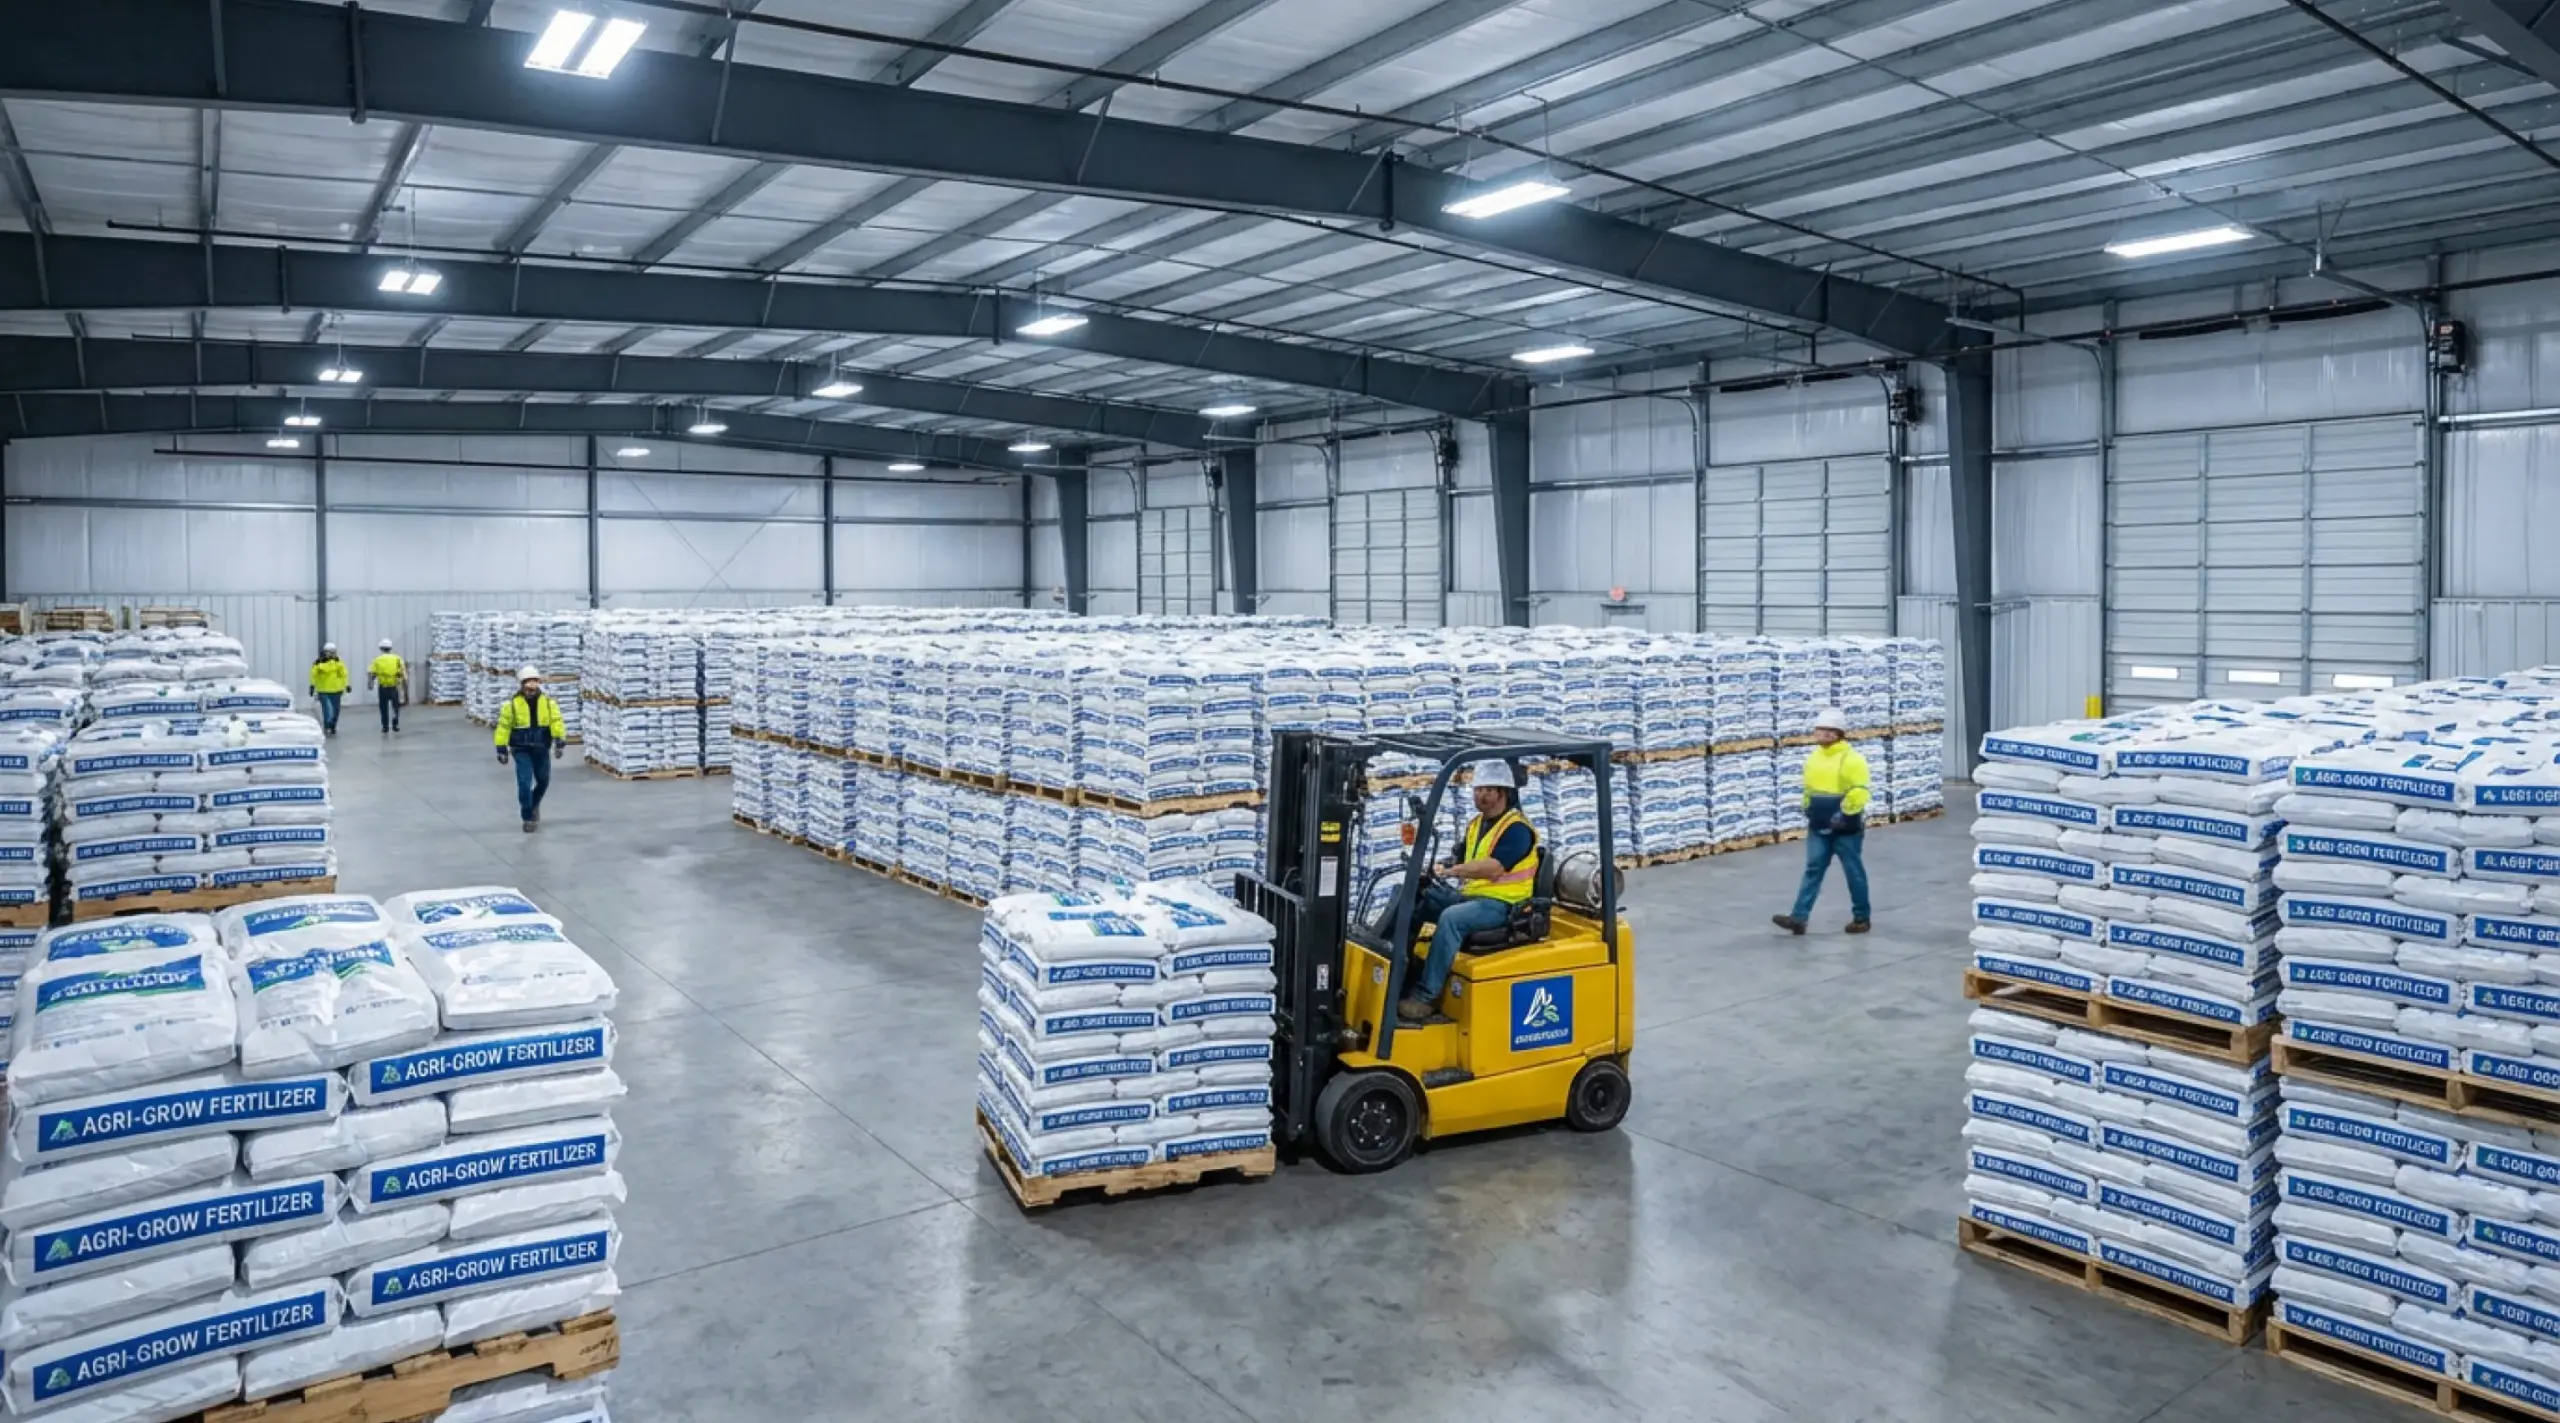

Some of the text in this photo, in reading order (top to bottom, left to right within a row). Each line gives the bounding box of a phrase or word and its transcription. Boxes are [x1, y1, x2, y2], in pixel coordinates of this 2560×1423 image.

[405, 1046, 503, 1081] AGRI-GROW
[81, 1087, 316, 1137] AGRI-GROW FERTILIZER
[405, 1143, 597, 1190] AGRI-GROW FERTILIZER
[77, 1192, 313, 1255] AGRI-GROW FERTILIZER
[77, 1304, 313, 1381] AGRI-GROW FERTILIZER
